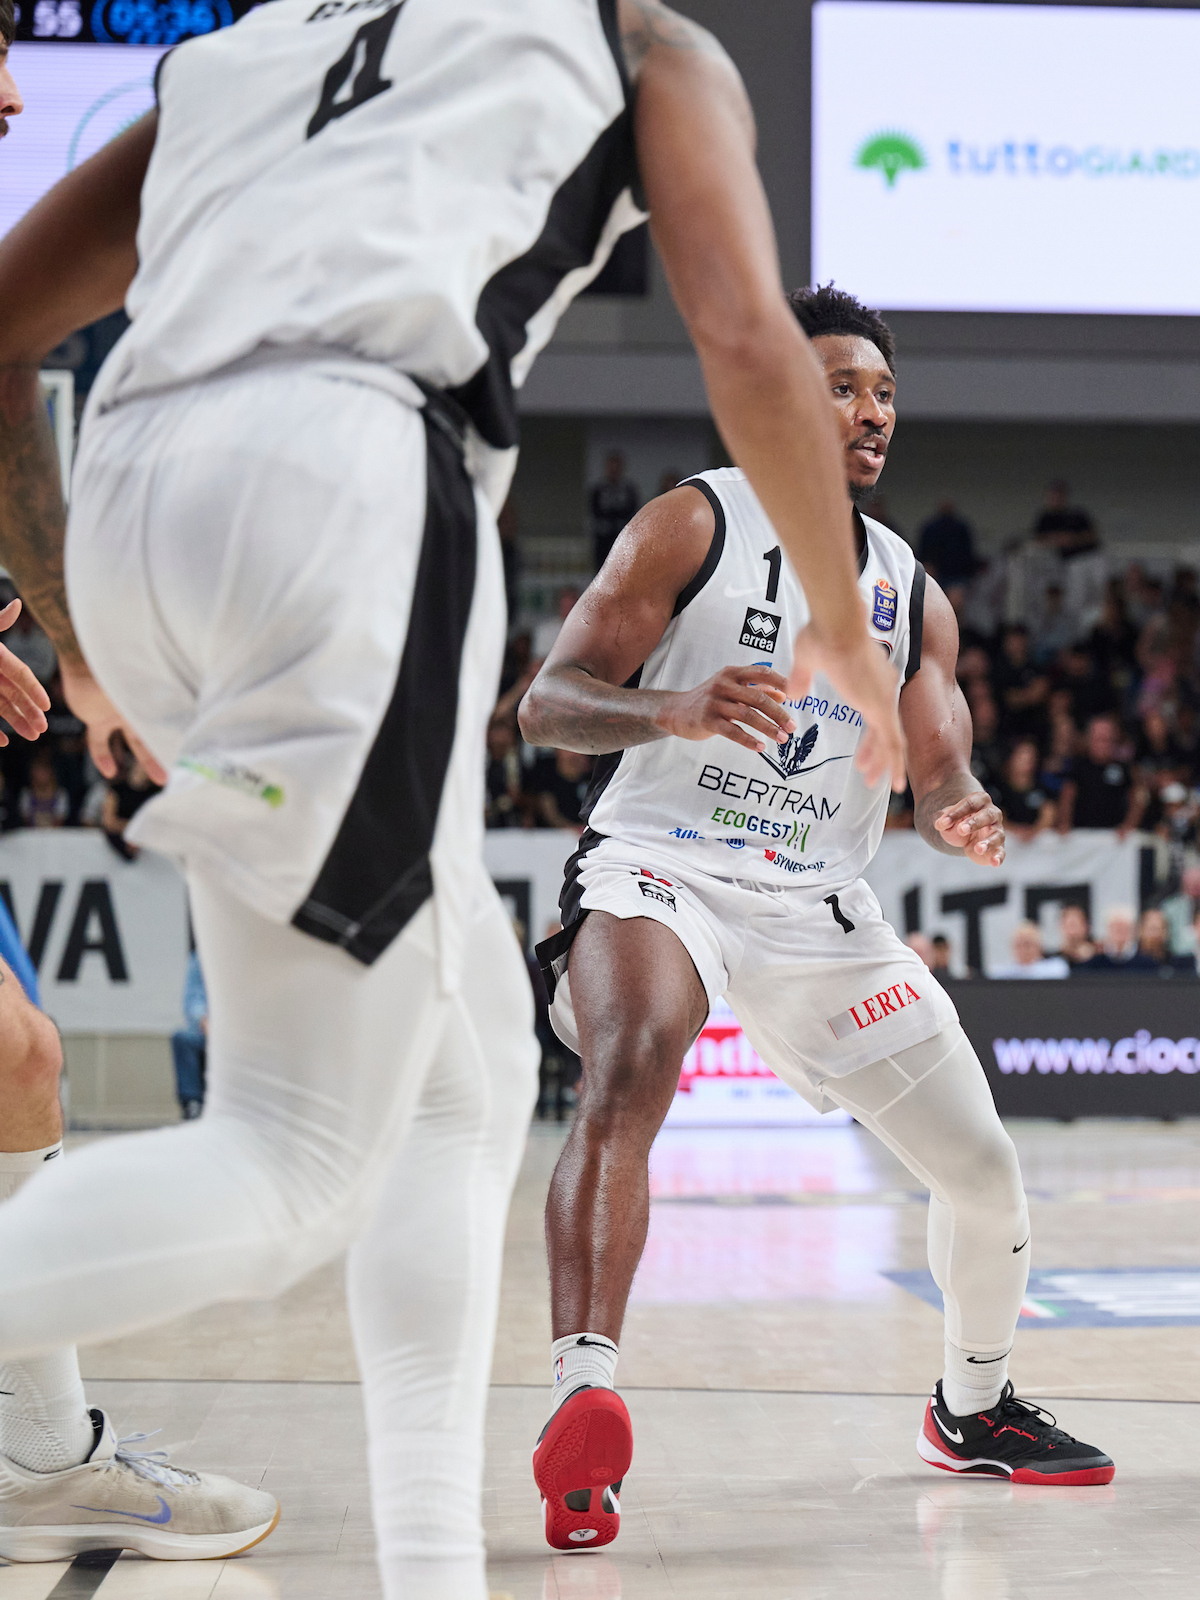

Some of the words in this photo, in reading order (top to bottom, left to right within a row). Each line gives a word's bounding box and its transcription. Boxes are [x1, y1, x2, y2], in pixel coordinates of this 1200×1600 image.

[763, 545, 782, 603] 1
[877, 596, 895, 612] LBA
[741, 631, 774, 652] errea
[697, 764, 841, 824] BERTRAM
[711, 807, 791, 840] ECOGEST
[823, 893, 856, 934] 1
[848, 981, 921, 1031] LERTA
